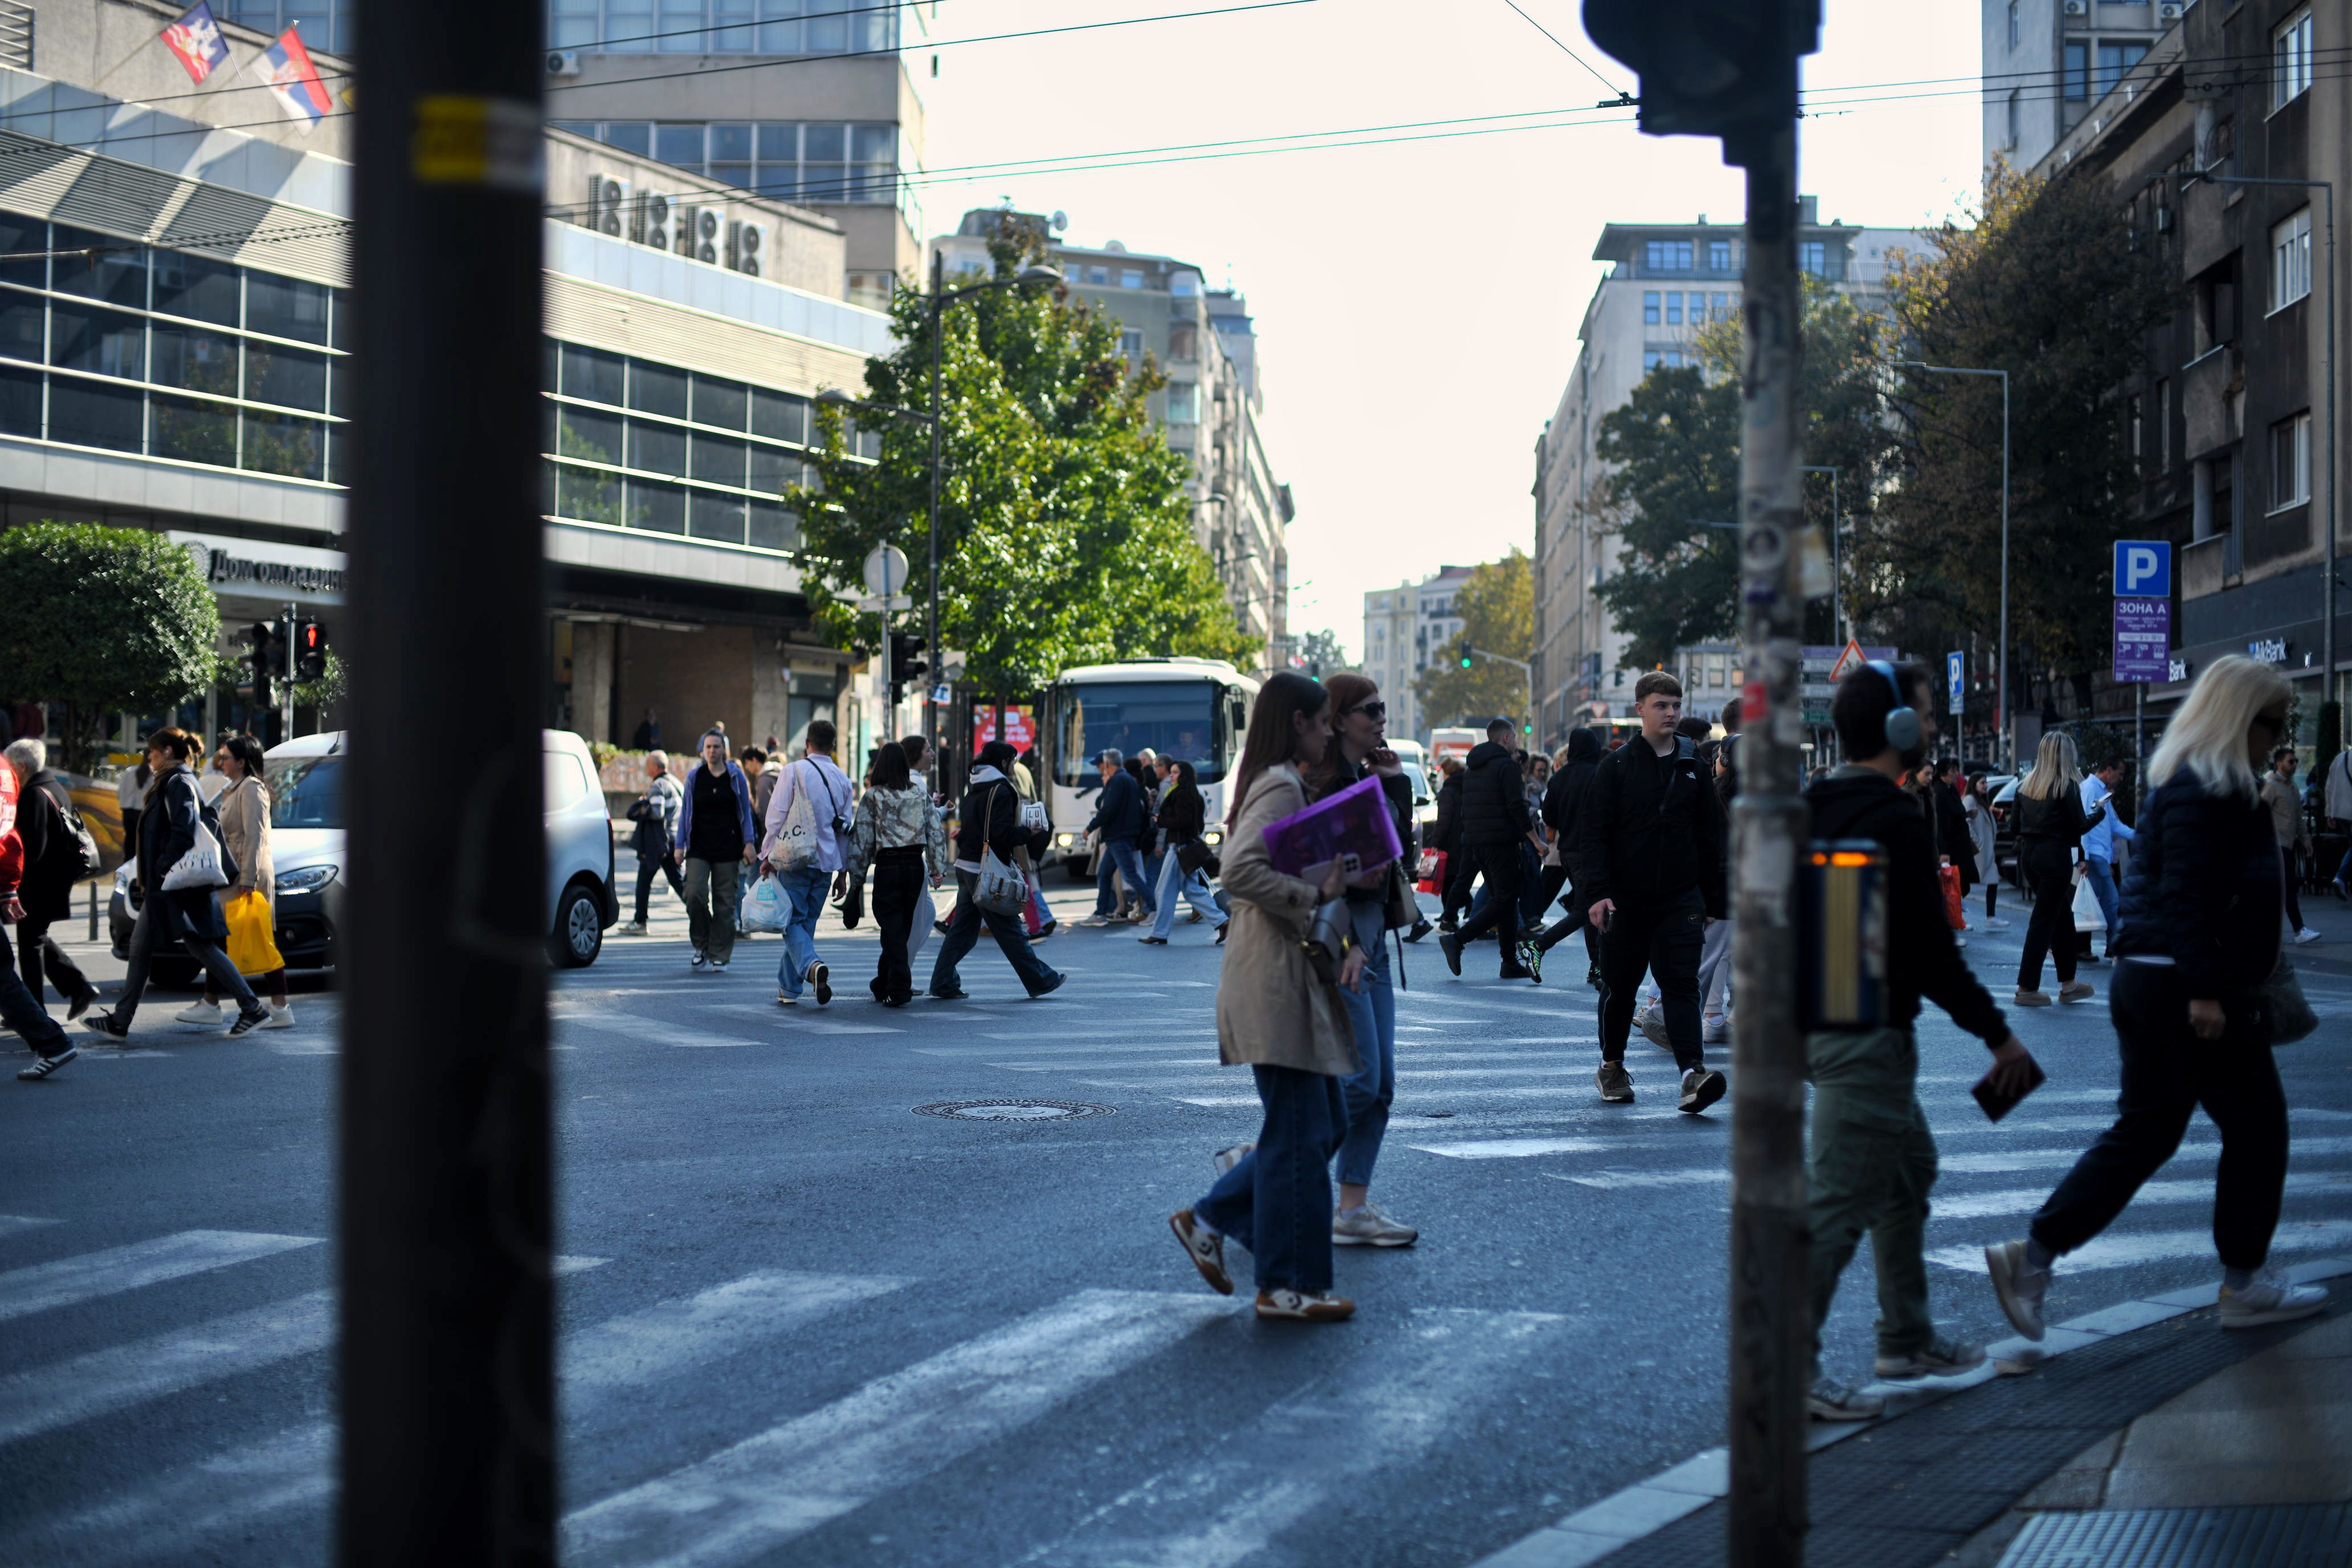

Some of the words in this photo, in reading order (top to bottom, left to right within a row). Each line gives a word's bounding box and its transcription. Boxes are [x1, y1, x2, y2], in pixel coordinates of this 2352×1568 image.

[211, 549, 254, 583] Дом
[2127, 548, 2158, 590] P
[2120, 602, 2153, 614] ЗОНА
[2169, 658, 2186, 682] Bank
